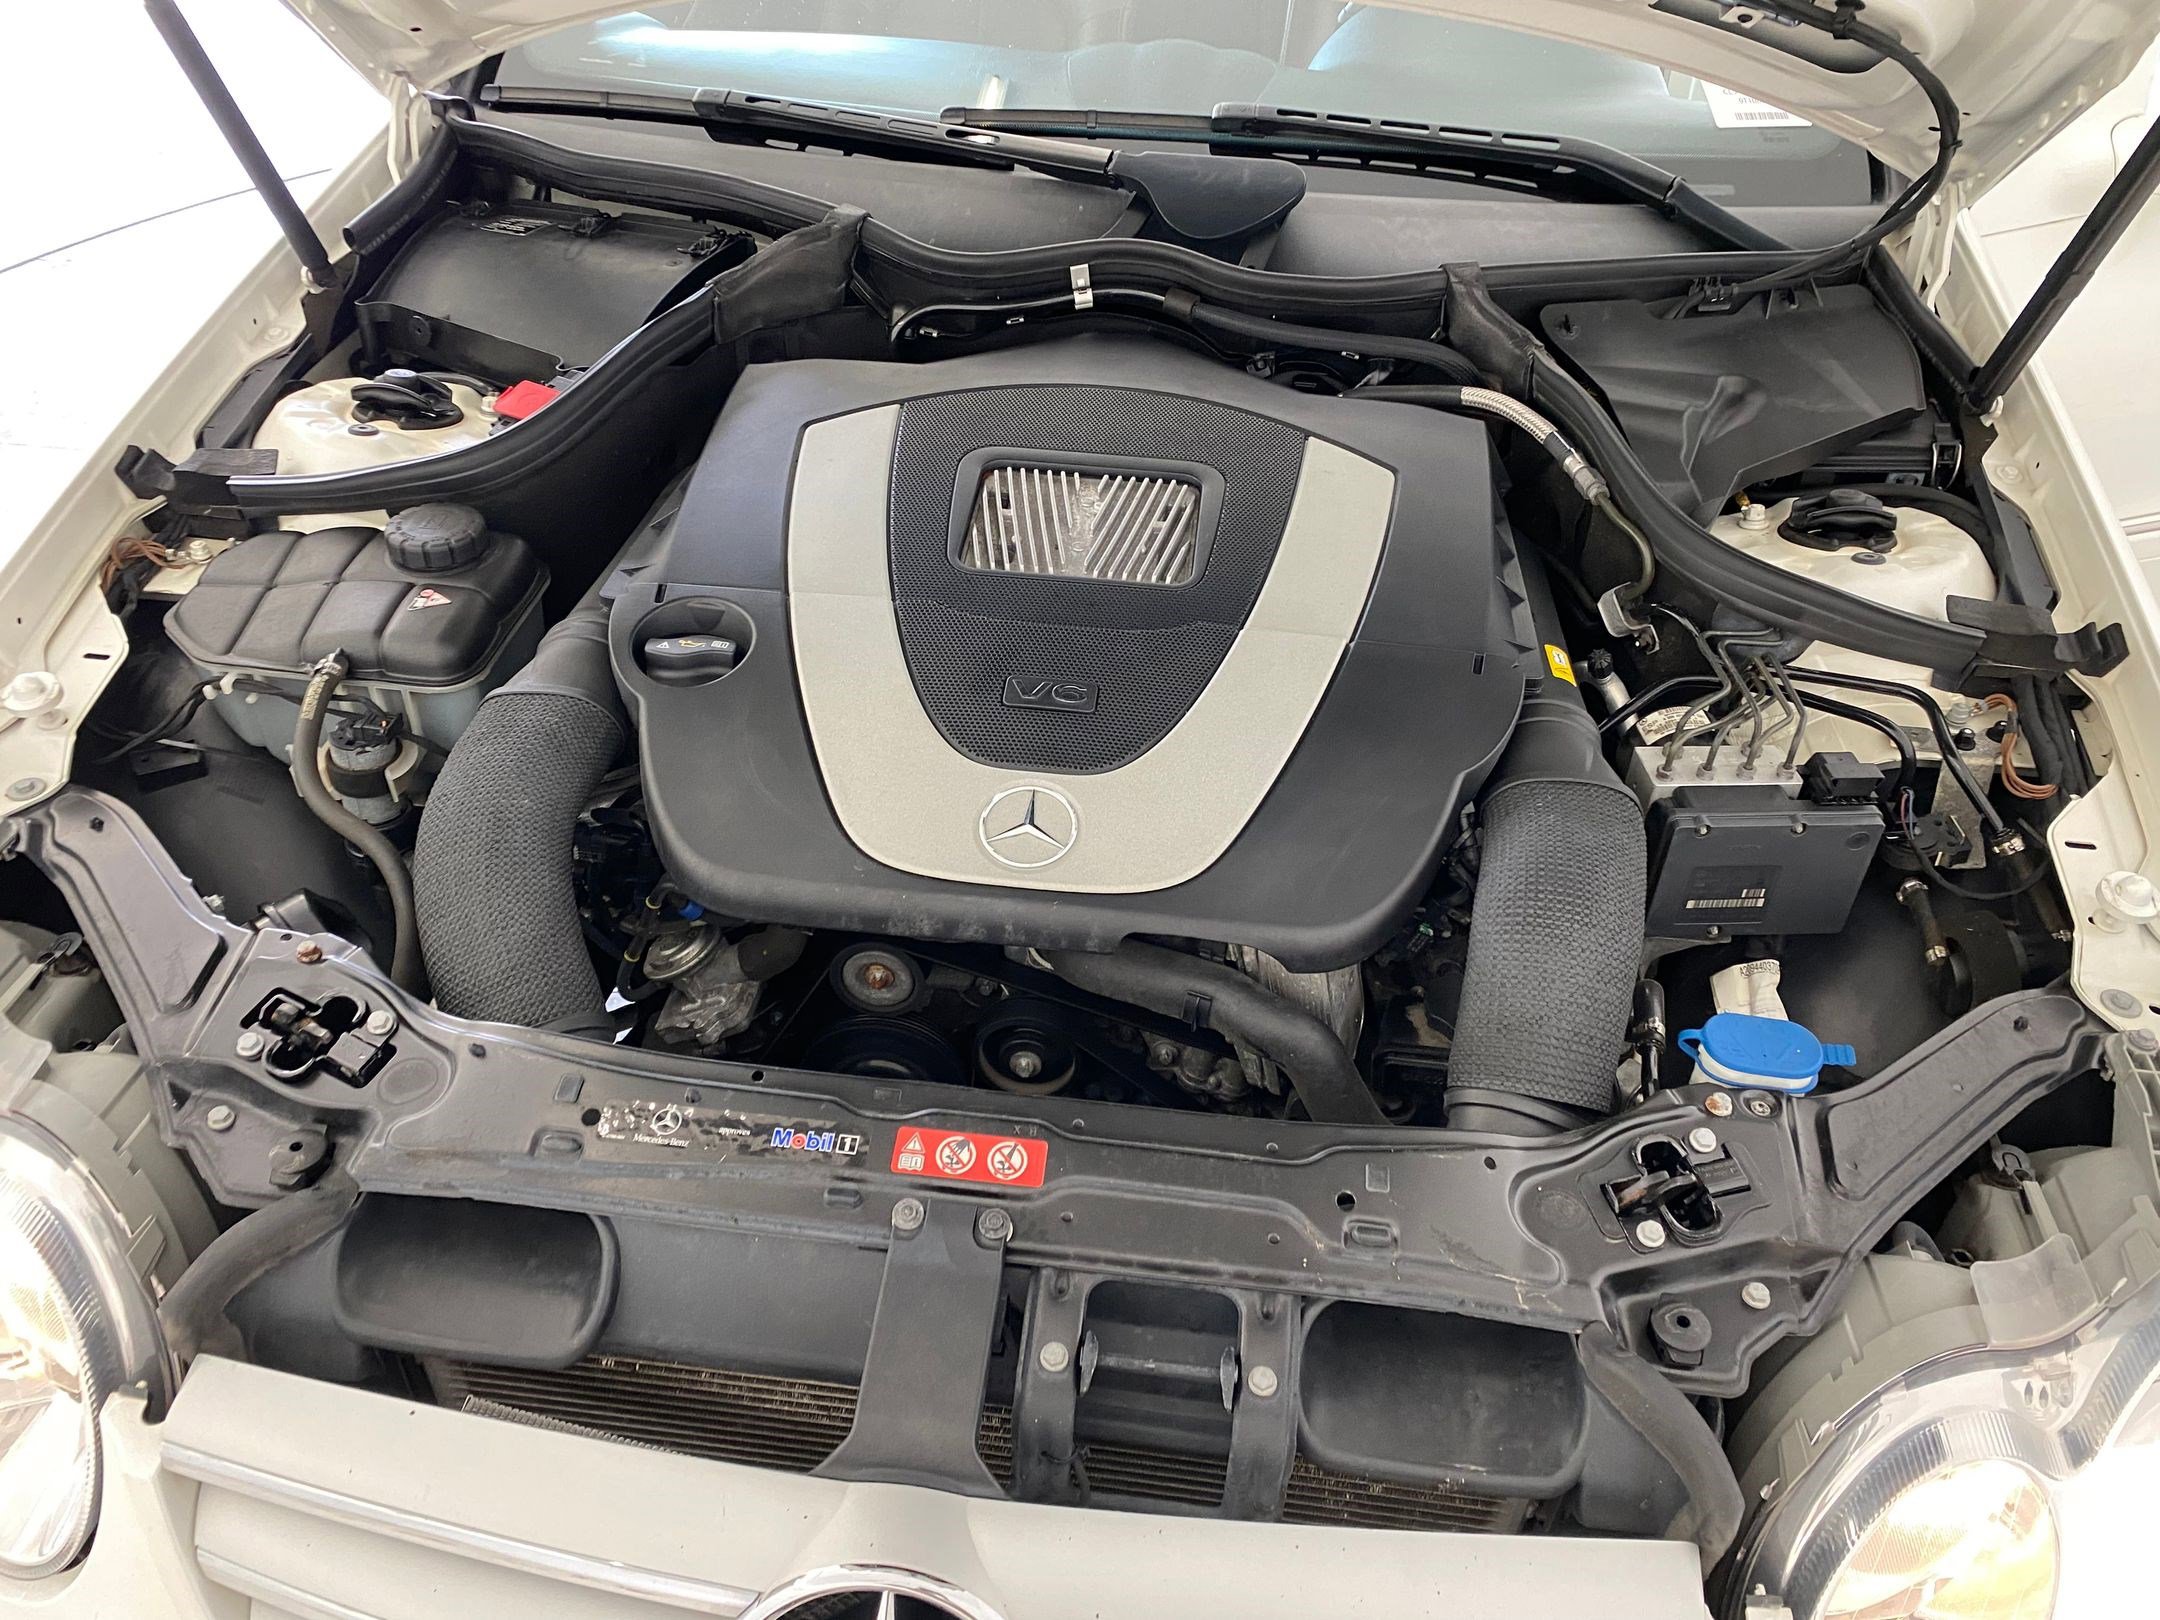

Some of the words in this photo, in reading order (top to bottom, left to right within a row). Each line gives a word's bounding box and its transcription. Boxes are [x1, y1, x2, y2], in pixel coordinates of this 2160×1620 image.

[1012, 680, 1087, 703] V6
[632, 1133, 690, 1148] Mercedes-Benz
[770, 1127, 835, 1152] Mobil
